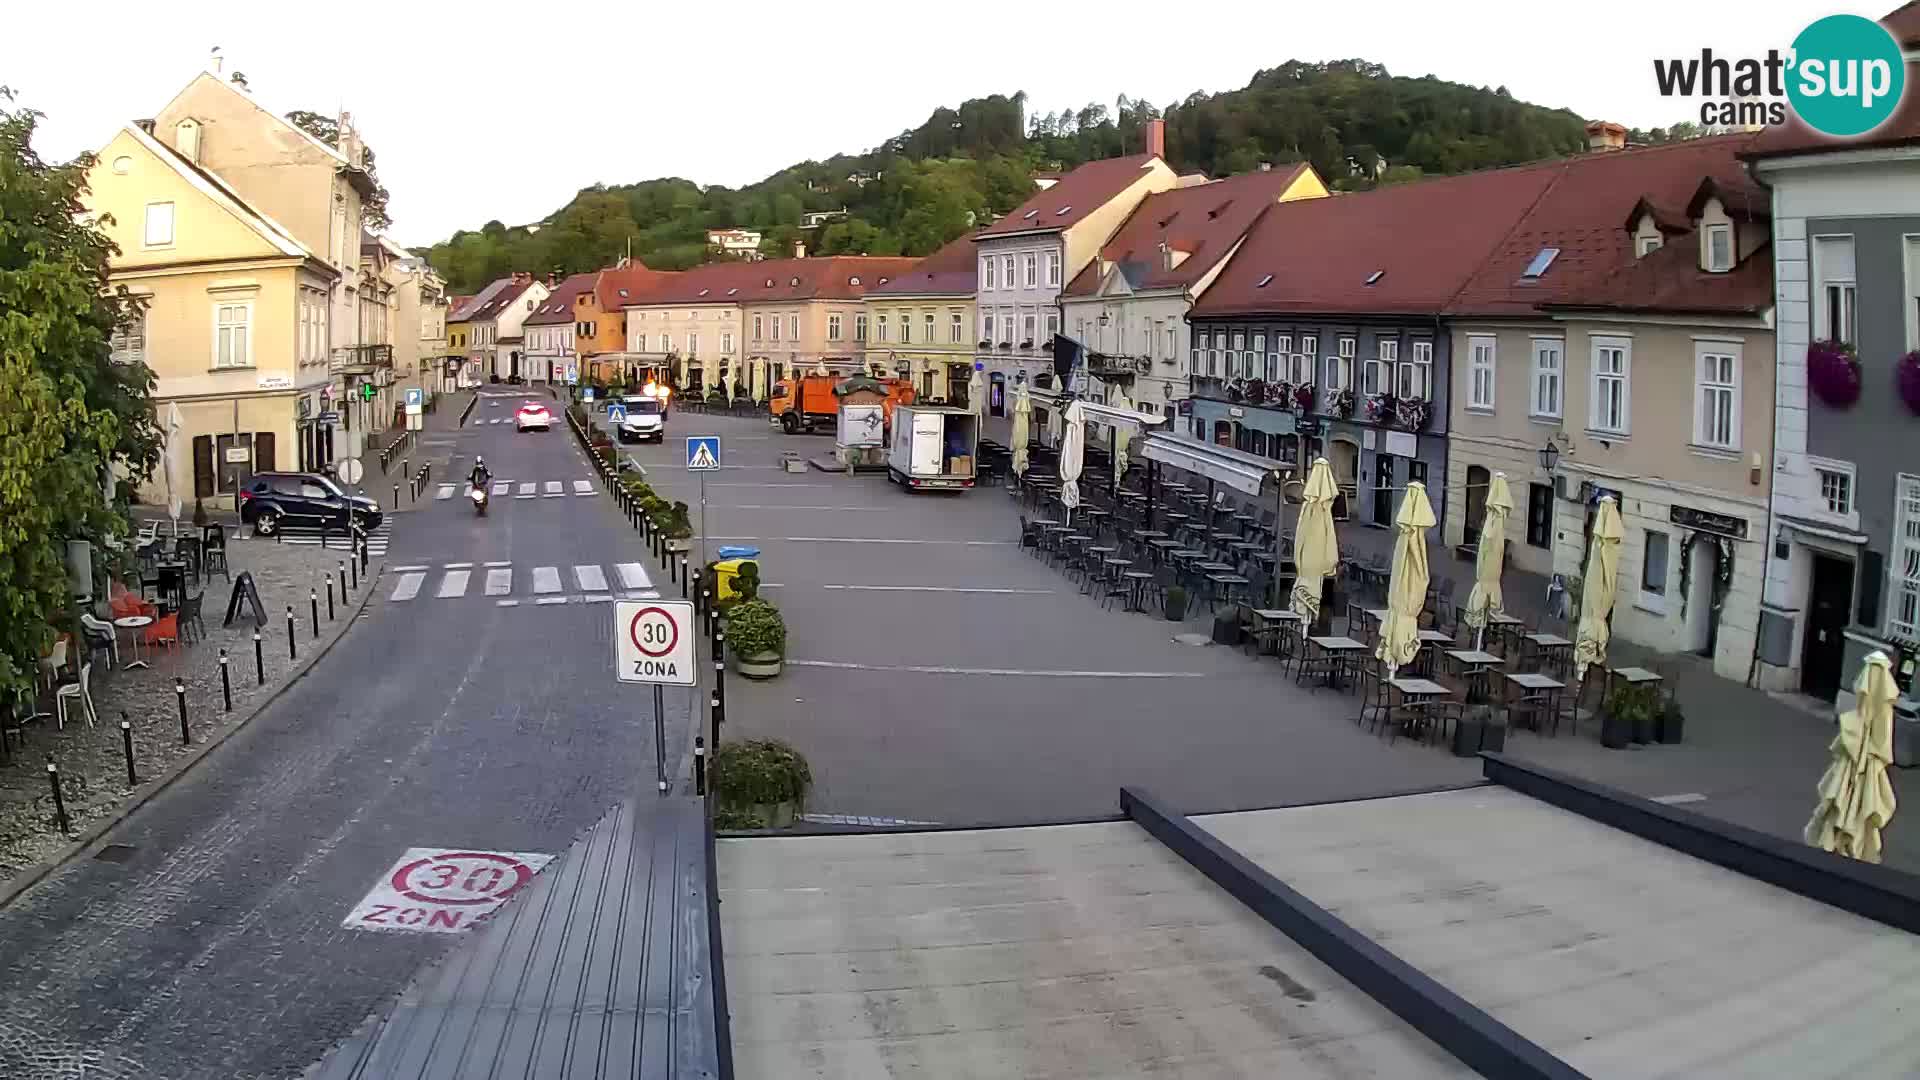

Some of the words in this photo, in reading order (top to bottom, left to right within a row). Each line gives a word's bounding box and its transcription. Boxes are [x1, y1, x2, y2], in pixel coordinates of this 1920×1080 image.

[643, 623, 667, 644] 30
[633, 661, 677, 677] ZONA
[420, 864, 503, 892] 30
